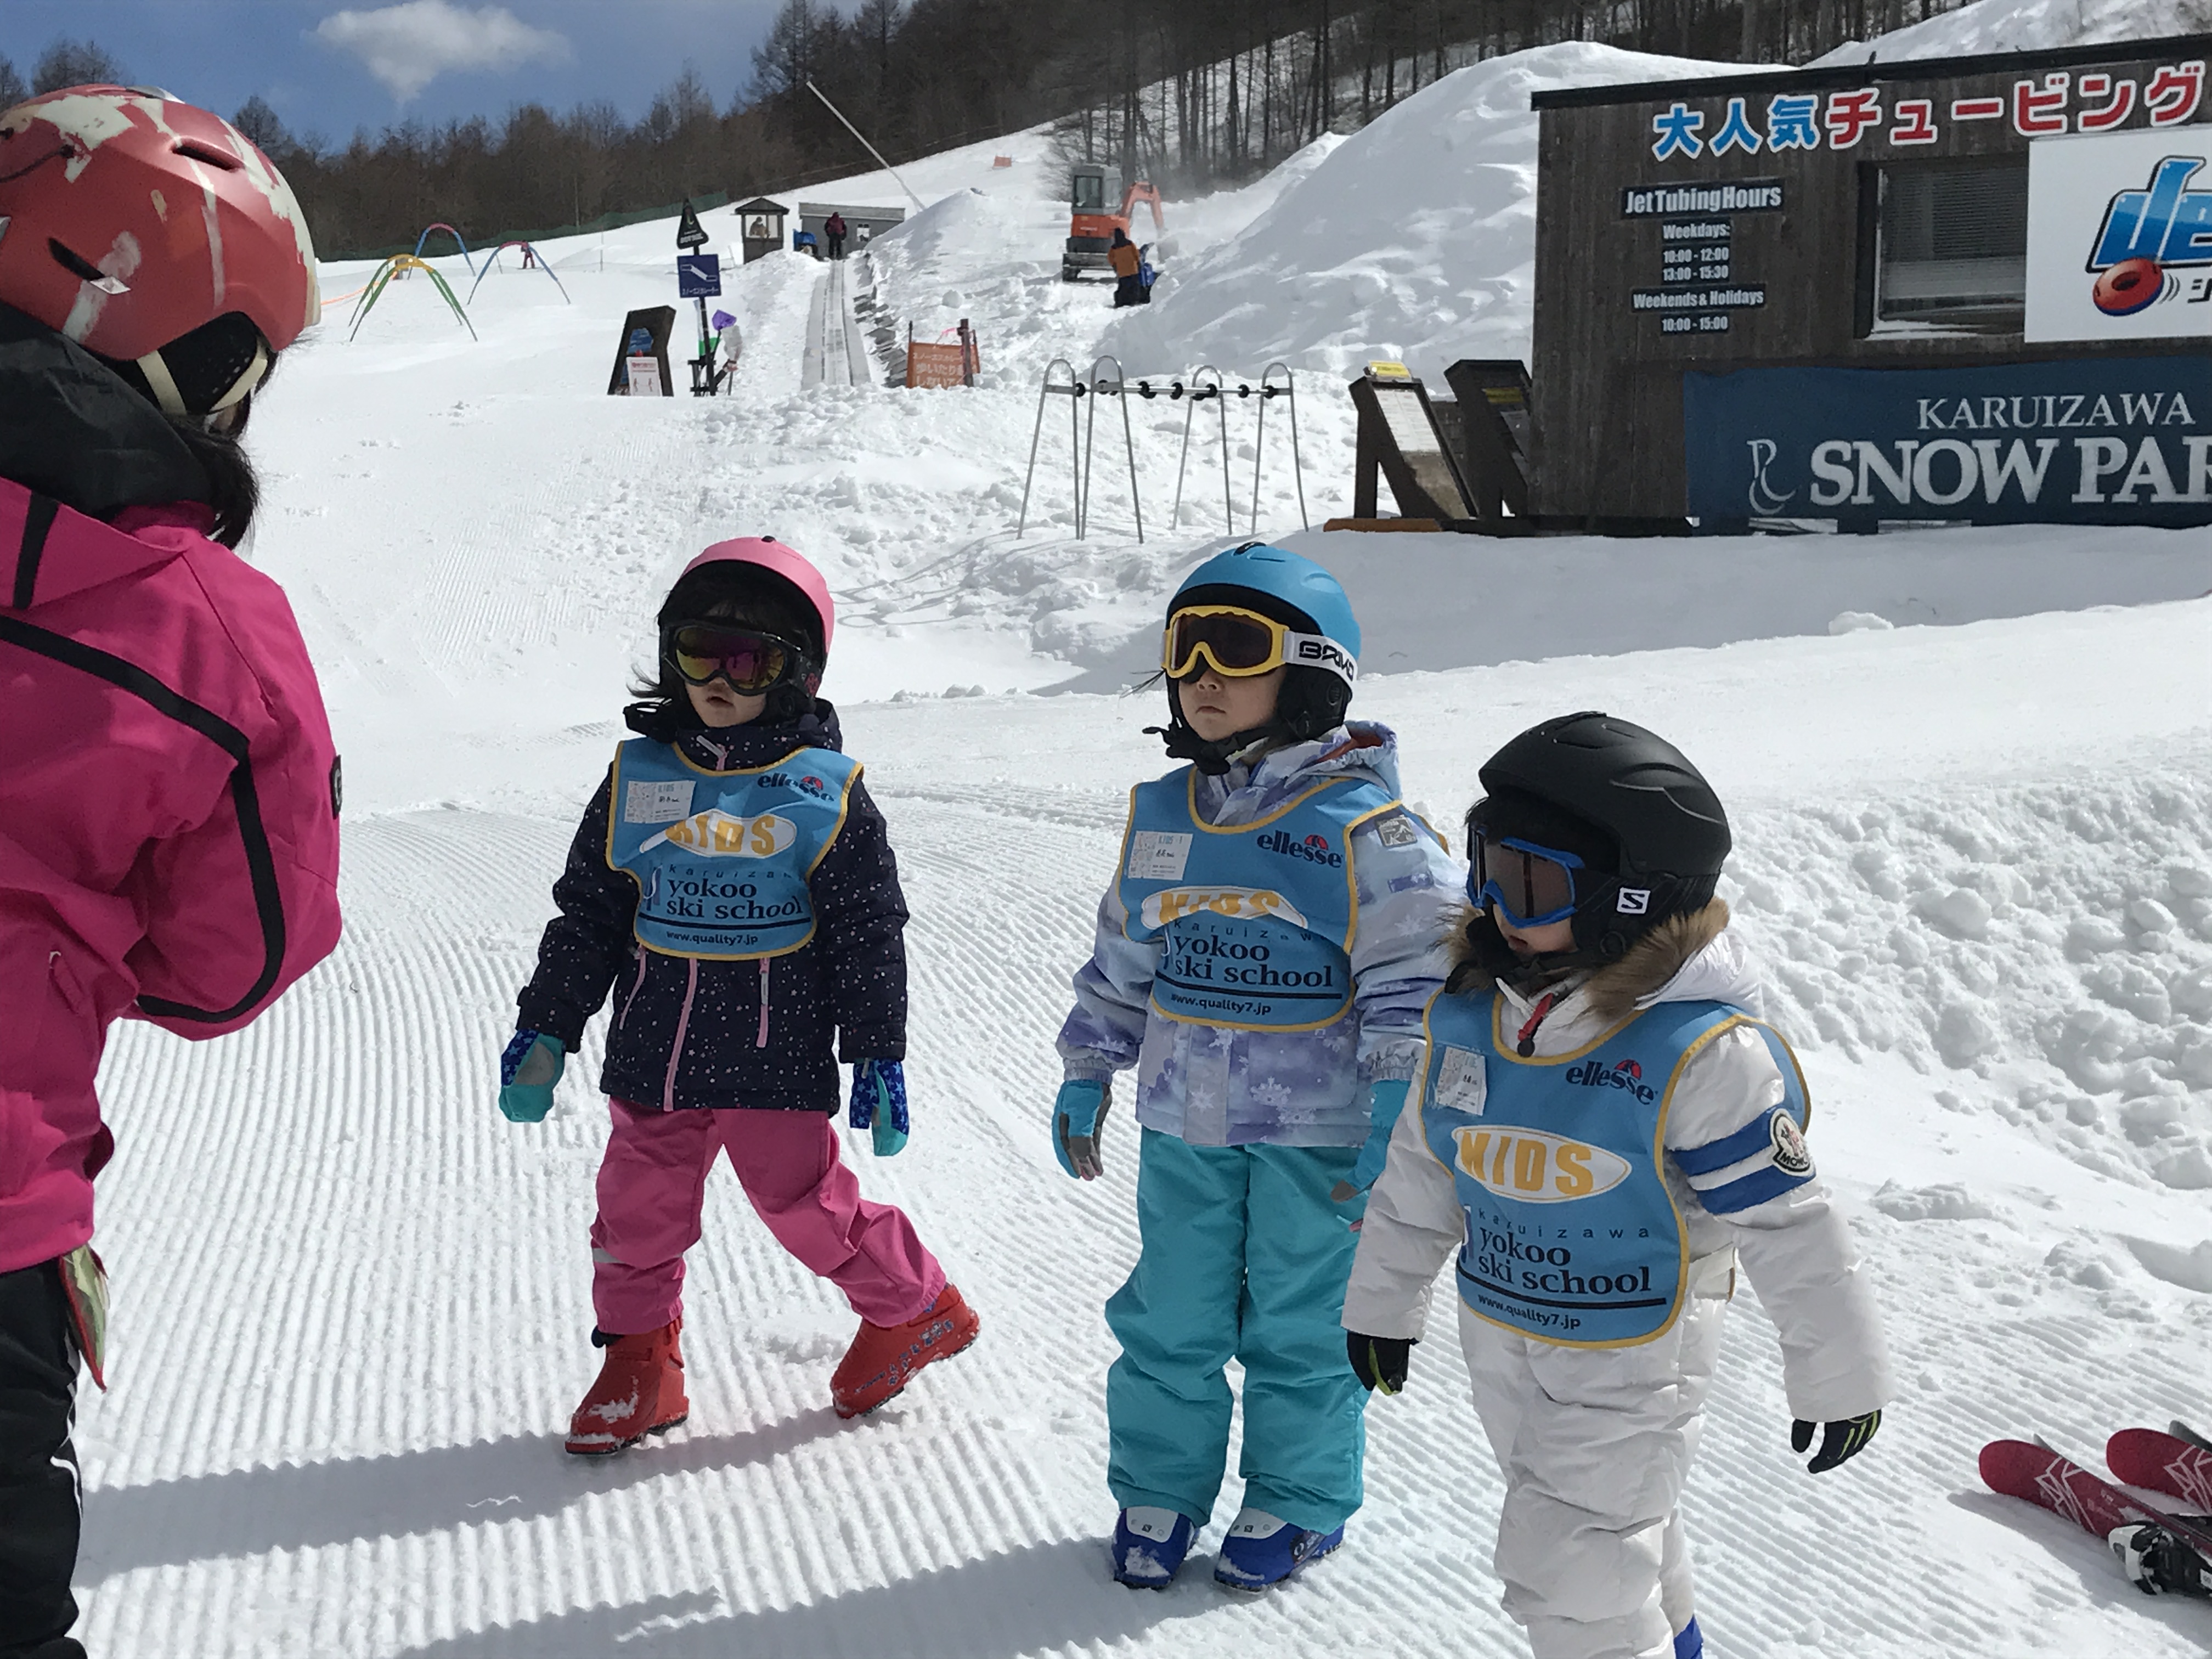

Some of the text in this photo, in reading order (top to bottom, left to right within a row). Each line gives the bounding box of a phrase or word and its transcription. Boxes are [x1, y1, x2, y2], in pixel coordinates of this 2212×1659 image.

[1652, 60, 2205, 161] 大人気チュービング
[1663, 223, 1730, 239] Weekdays:
[1663, 249, 1692, 263] 10:00
[1700, 247, 1729, 262] 12:00
[1663, 267, 1691, 281] 13:00
[1700, 265, 1729, 279] 15:30
[1633, 290, 1764, 308] Weekends & Holidays
[1662, 318, 1691, 332] 10:00
[1699, 317, 1728, 330] 15:00
[1916, 393, 2196, 430] KARUIZAWA
[1810, 438, 2060, 506] SNOW
[1257, 830, 1342, 868] ellesse
[667, 878, 757, 898] yokoo
[666, 895, 804, 919] ski school
[1173, 935, 1270, 961] yokoo
[1175, 955, 1333, 988] ski school
[1566, 1060, 1655, 1105] ellesse
[1461, 1131, 1593, 1195] KIDS
[1480, 1227, 1571, 1266] yokoo
[1479, 1252, 1651, 1295] ski school
[1477, 1294, 1581, 1329] www.quality7.jp
